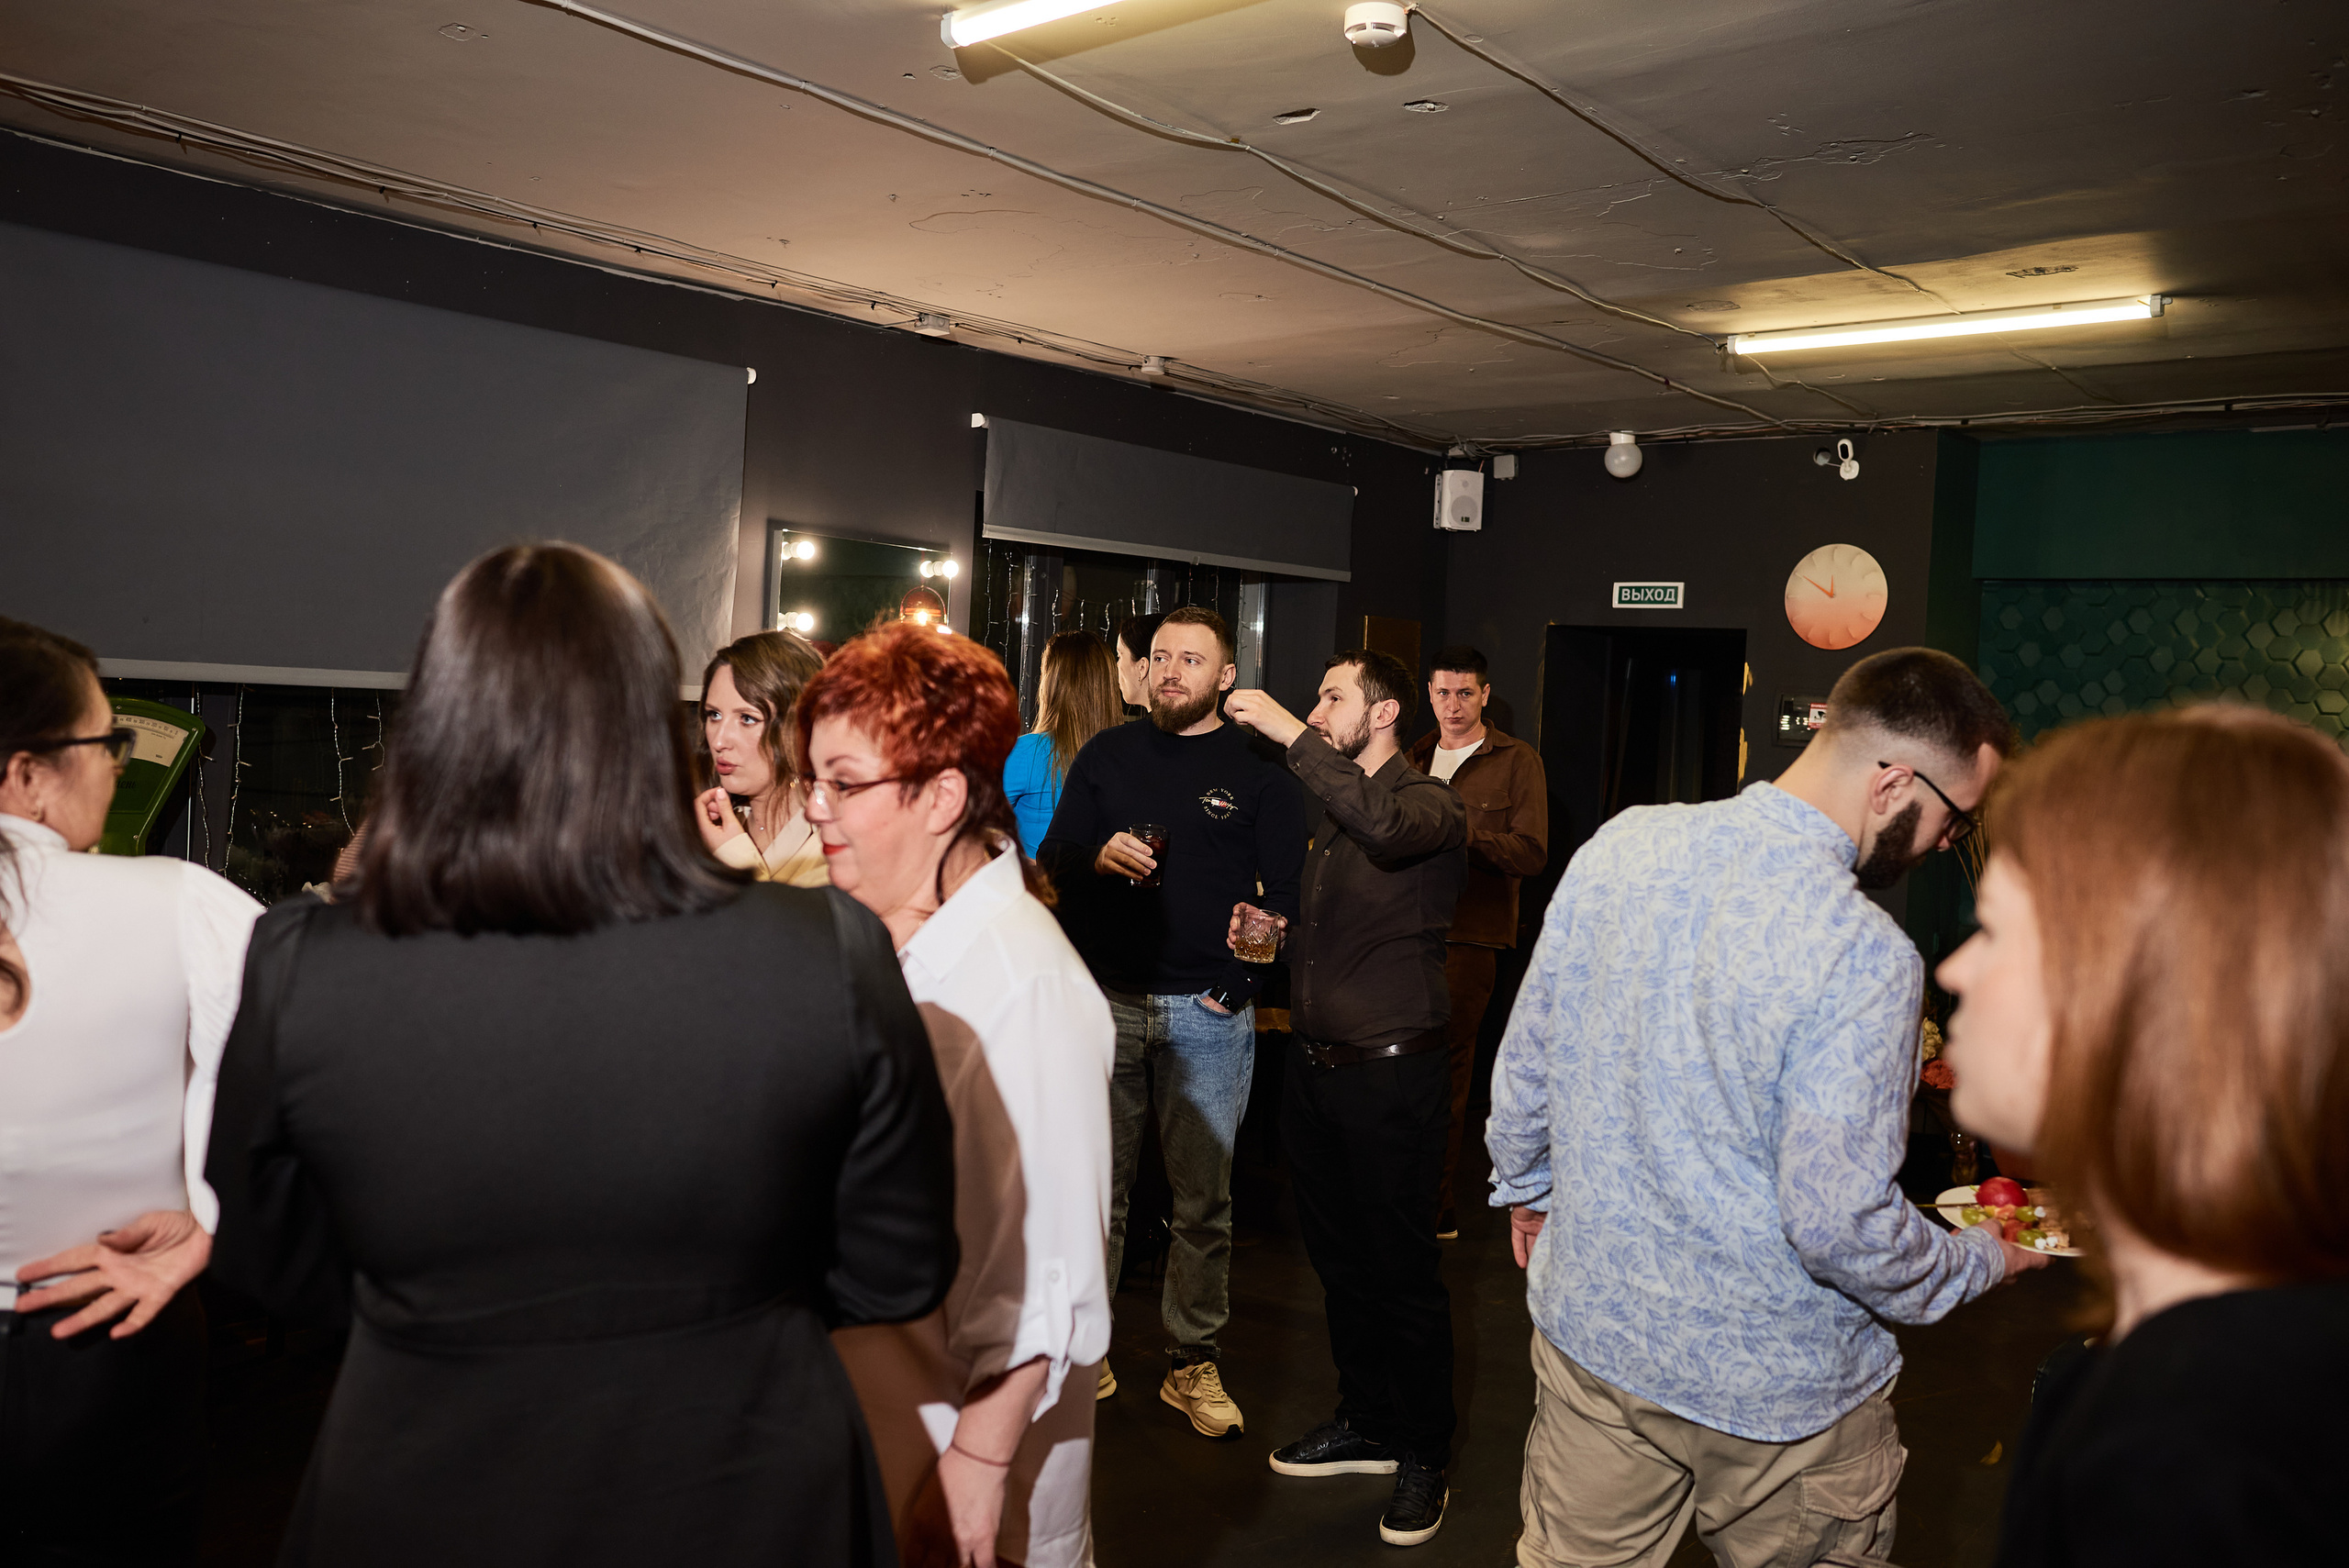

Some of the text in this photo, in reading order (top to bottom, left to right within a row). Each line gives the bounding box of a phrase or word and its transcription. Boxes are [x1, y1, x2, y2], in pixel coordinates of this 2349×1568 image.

[1621, 588, 1675, 602] ВЫХОД
[1206, 787, 1234, 801] NEW YORK
[1203, 806, 1219, 819] SINCE
